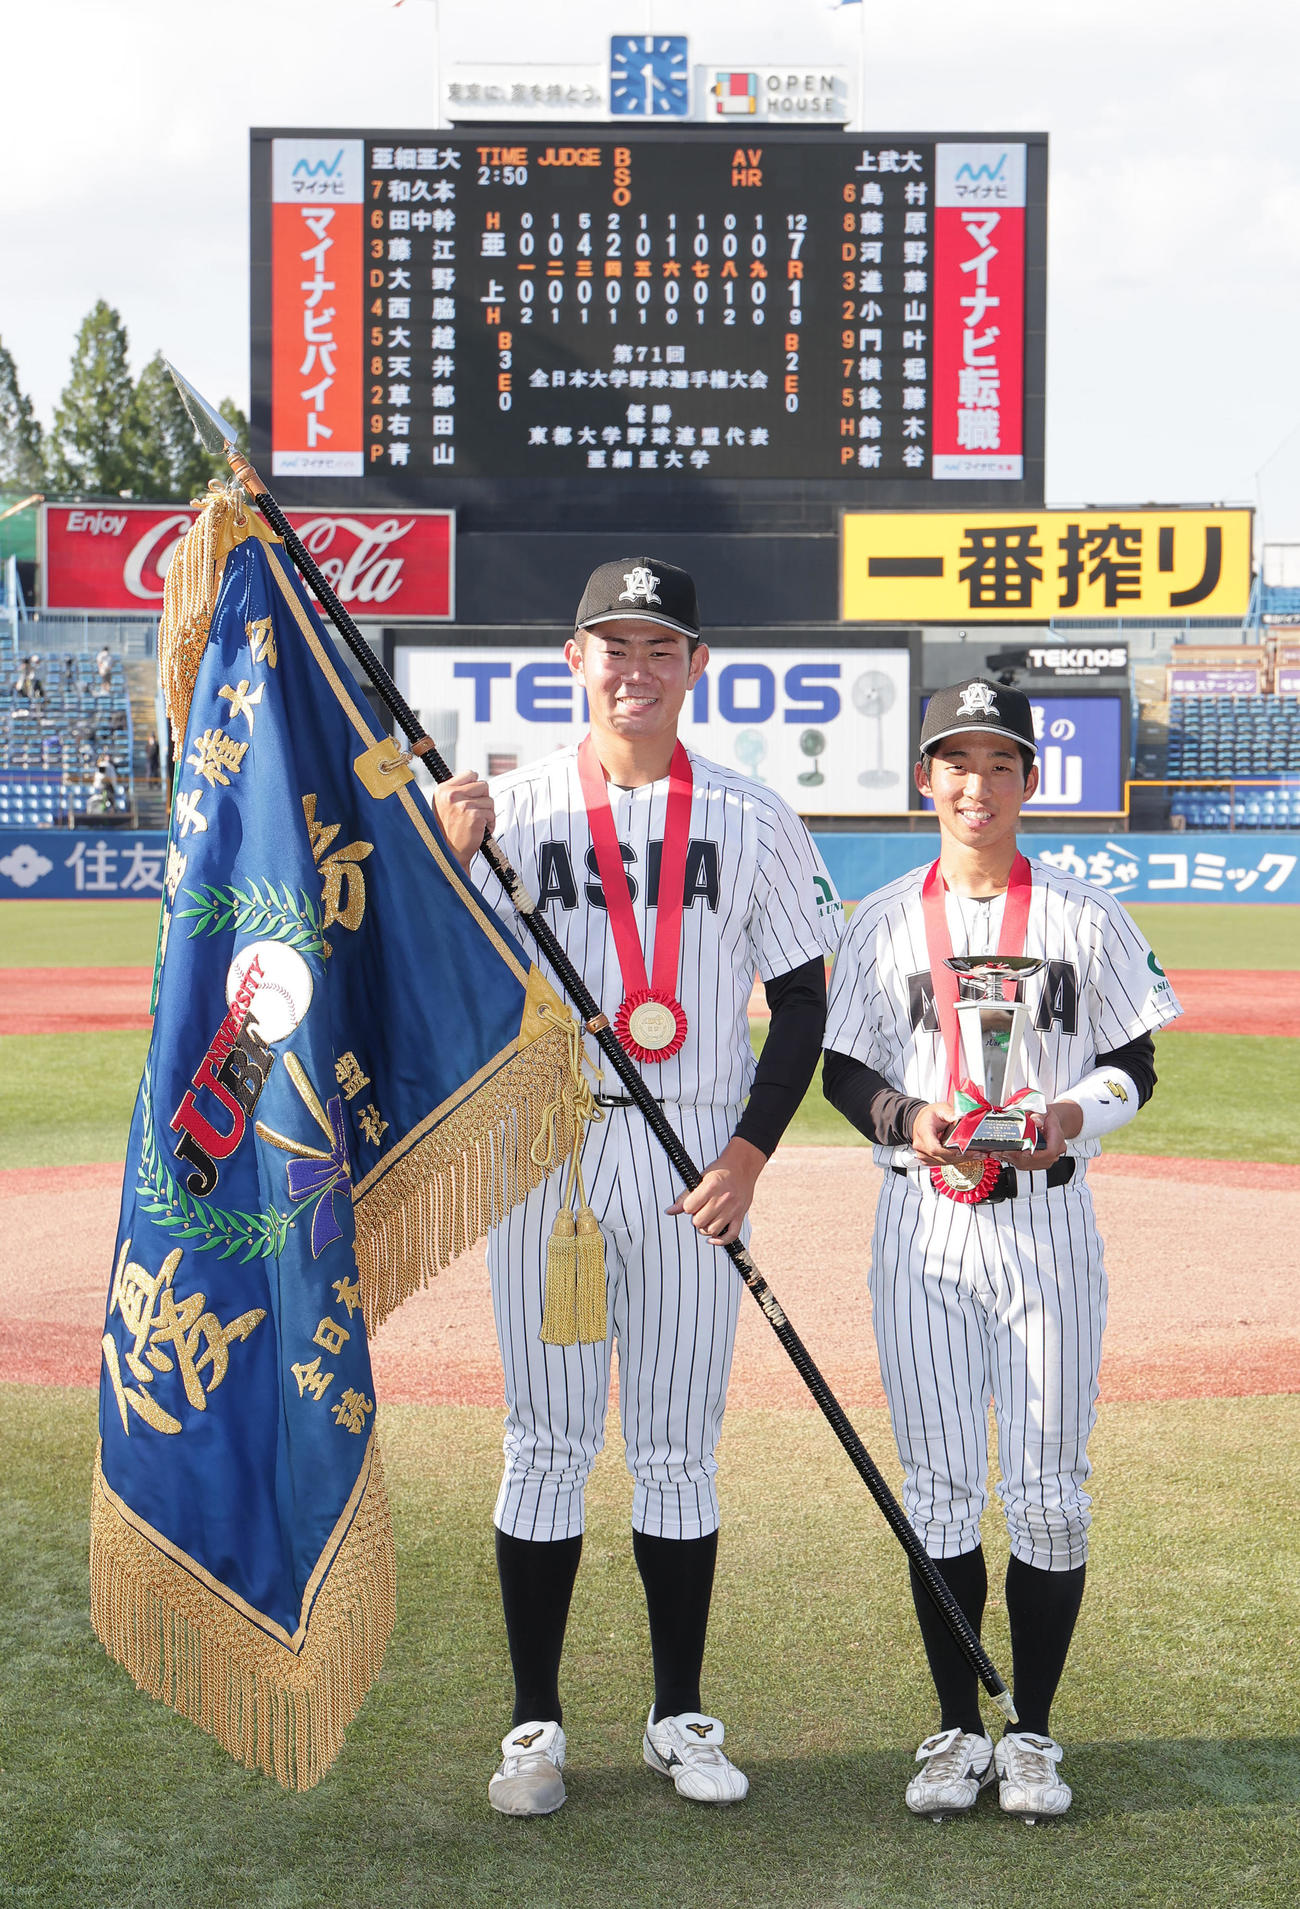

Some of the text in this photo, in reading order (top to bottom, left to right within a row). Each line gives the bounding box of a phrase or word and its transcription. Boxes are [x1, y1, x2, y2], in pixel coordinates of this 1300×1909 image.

[767, 75, 834, 92] OPEN
[768, 97, 833, 112] HOUSE
[372, 147, 461, 170] 亜細亜大
[477, 147, 601, 167] TIME JUDGE
[732, 149, 762, 167] AV
[855, 150, 923, 173] 上武大
[478, 167, 528, 185] 2:50
[732, 168, 762, 186] HR
[292, 180, 345, 195] マイナビ
[372, 179, 455, 203] 7 和久本
[843, 184, 856, 202] 6
[955, 185, 1008, 199] マイナビ
[371, 210, 383, 229] 6
[486, 212, 807, 230] H 0 1 5 2 1 1 1 0 1 12
[843, 213, 855, 232] 8
[371, 239, 383, 258] 3
[480, 232, 805, 259] 亜 0 0 4 2 0 1 0 0 0 7
[842, 243, 856, 261] D
[370, 269, 384, 287] D
[546, 261, 564, 276] 二
[575, 260, 593, 277] 三
[604, 261, 622, 277] 四
[634, 261, 652, 277] 五
[663, 260, 680, 277] 六
[691, 261, 710, 278] 七
[721, 261, 738, 277] 八
[750, 260, 767, 278] 九
[788, 260, 803, 279] R
[843, 271, 855, 290] 3
[480, 279, 800, 307] 上 0 0 0 0 0 0 0 1 0 1
[371, 298, 382, 316] 4
[486, 307, 802, 325] H 2 1 1 1 1 0 1 2 0 9
[843, 300, 926, 322] 2 小山
[301, 206, 340, 449] マイナビバイト
[371, 327, 383, 346] 5
[957, 211, 1001, 451] マイナビ転職
[498, 331, 512, 350] B
[785, 333, 799, 351] B
[842, 330, 854, 349] 9
[500, 351, 512, 369] 3
[613, 344, 685, 363] 第71回
[786, 351, 799, 370] 2
[371, 355, 455, 378] 8 天井
[842, 359, 854, 377] 7
[498, 373, 512, 391] E
[529, 368, 768, 389] 全日本大学野球選手権大会
[784, 375, 798, 393] E
[371, 385, 383, 404] 2
[499, 392, 512, 411] 0
[786, 392, 798, 412] 0
[842, 388, 854, 407] 5
[371, 413, 454, 436] 9 右田
[840, 418, 854, 436] H
[528, 426, 769, 446] 東都大学野球連盟代表
[371, 442, 454, 465] P 青山
[588, 449, 709, 469] 亜細亜大学
[841, 445, 924, 468] P 新谷
[66, 511, 127, 536] Enjoy
[867, 524, 1222, 609] 一番搾り
[1029, 649, 1127, 668] TEKNOS
[453, 662, 841, 724] TEOS
[64, 841, 167, 892] 住友
